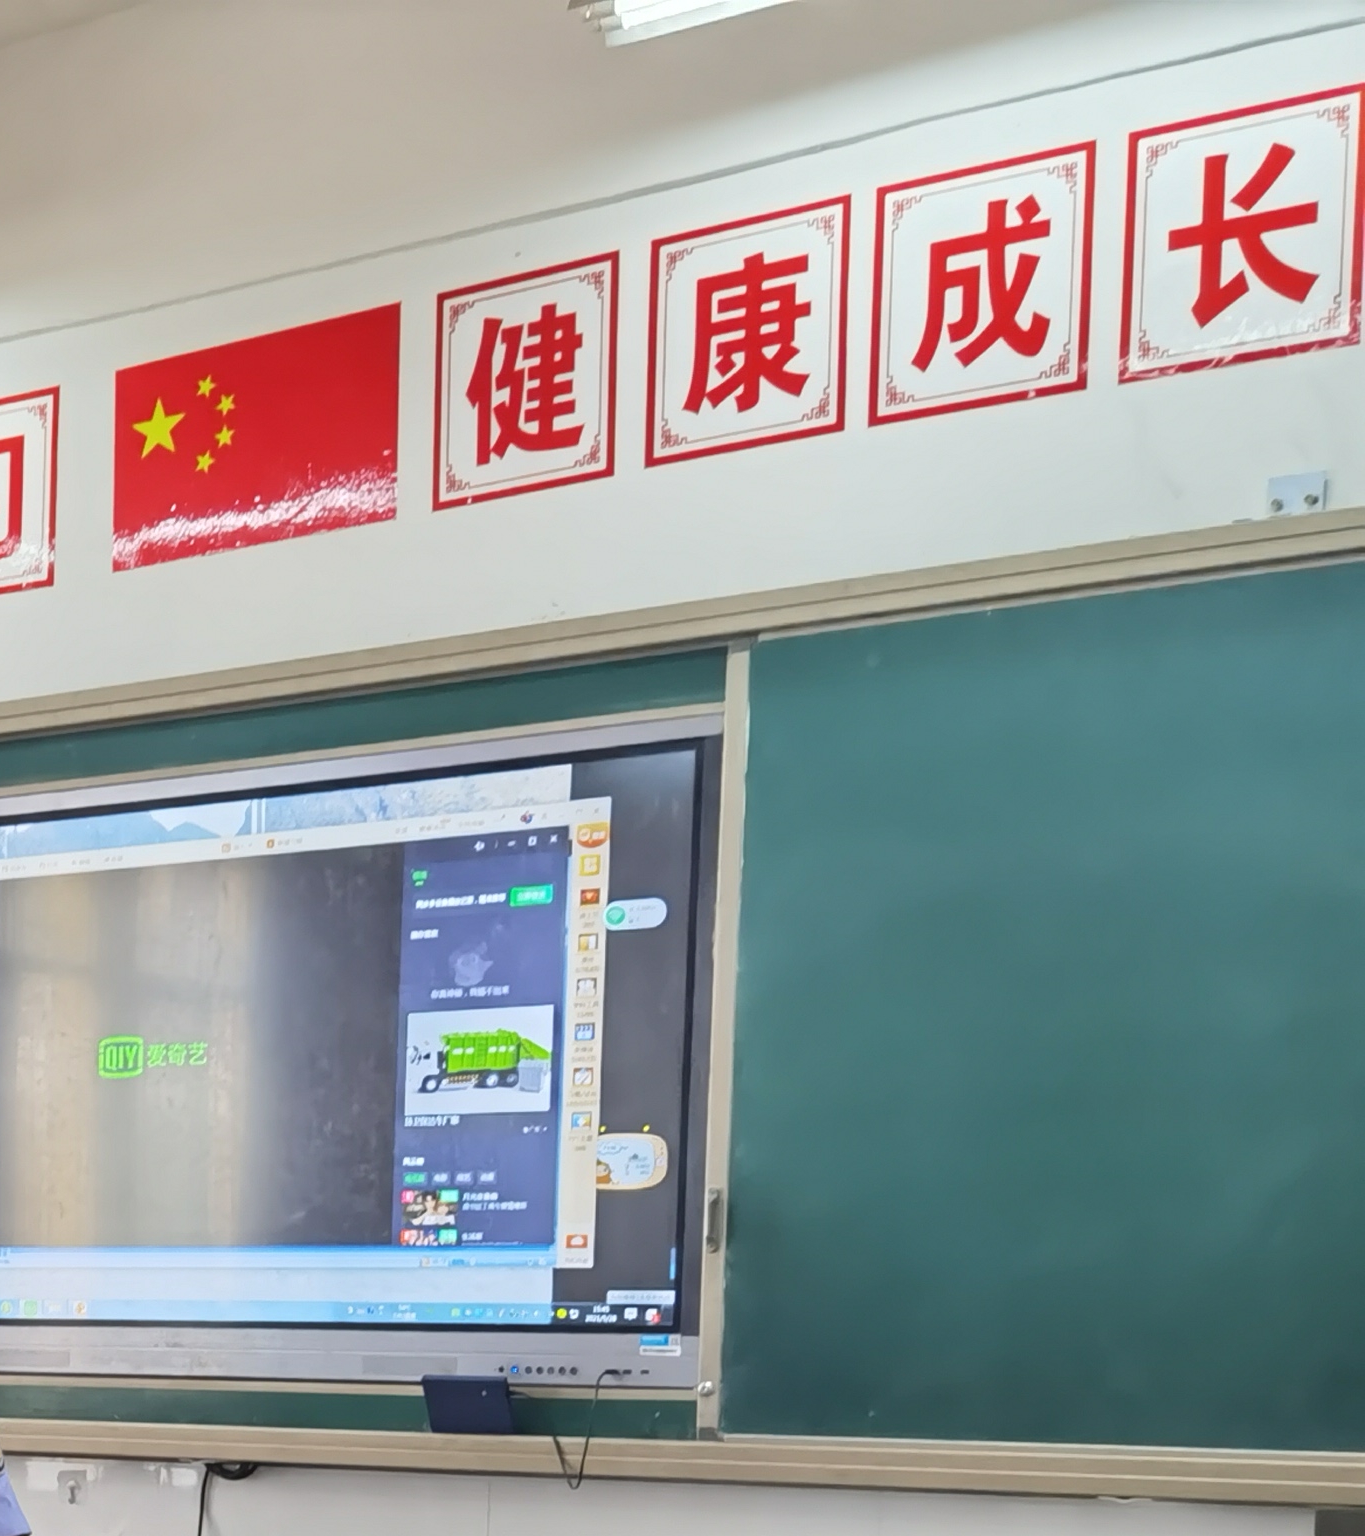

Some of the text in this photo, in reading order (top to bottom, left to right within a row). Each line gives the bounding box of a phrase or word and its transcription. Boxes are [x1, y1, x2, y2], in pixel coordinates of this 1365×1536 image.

[466, 141, 1321, 467] 健康成长
[146, 1041, 209, 1068] 爱奇艺
